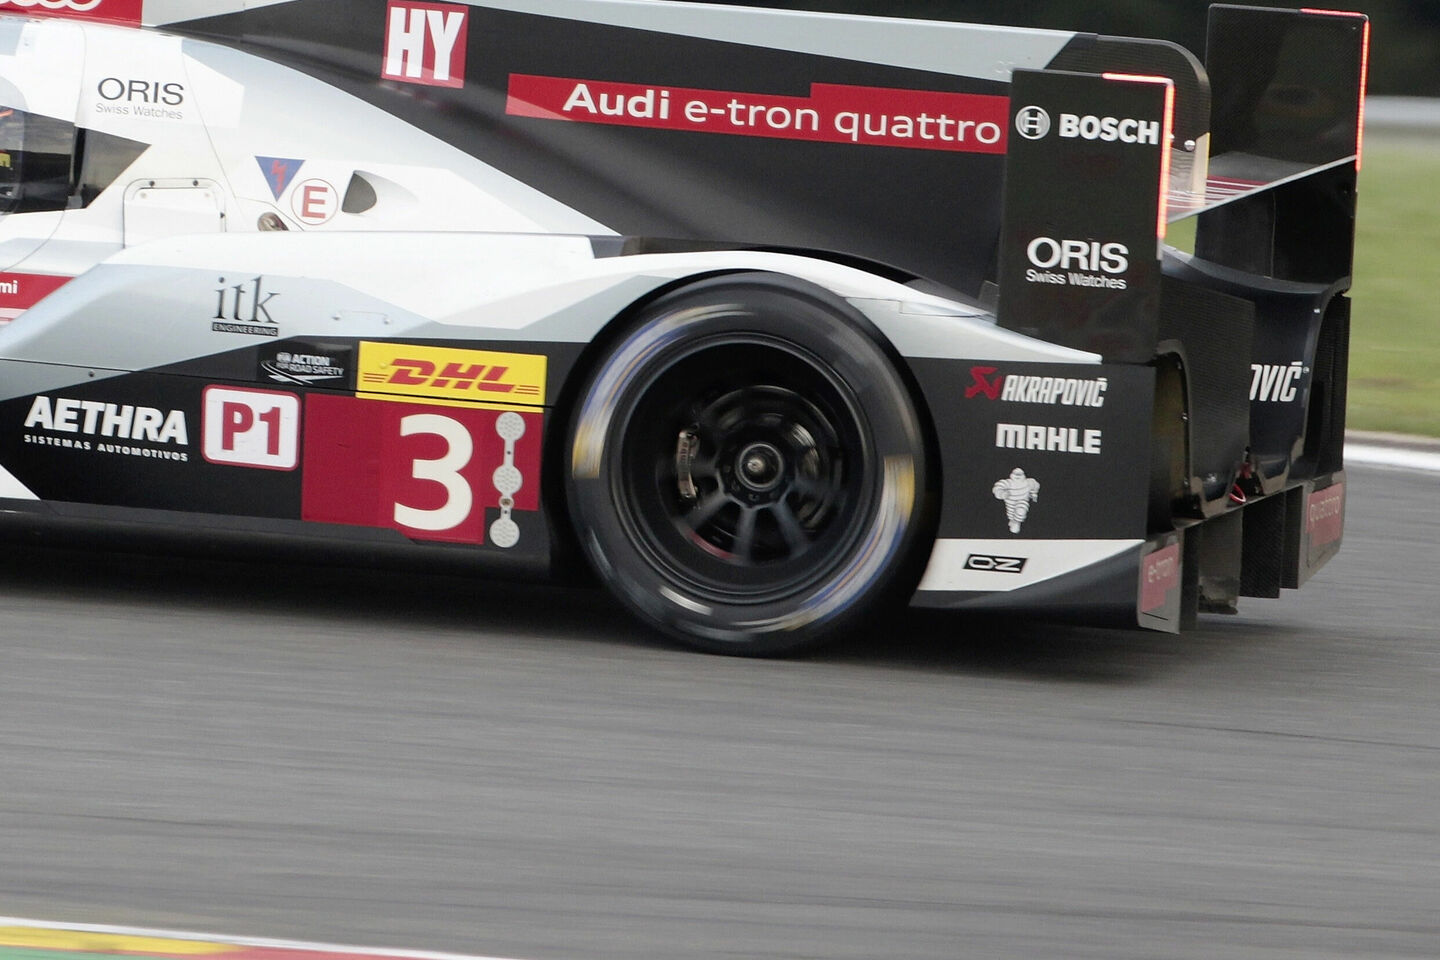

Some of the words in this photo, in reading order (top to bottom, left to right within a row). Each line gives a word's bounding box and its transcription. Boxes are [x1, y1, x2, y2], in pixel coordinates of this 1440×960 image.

[385, 6, 465, 81] HY
[97, 77, 184, 106] ORIS
[95, 102, 129, 115] Swiss
[133, 105, 184, 120] Watches
[562, 83, 670, 120] Audi
[683, 97, 819, 131] e-tron
[833, 110, 1001, 144] quattro
[1058, 113, 1160, 145] BOSCH
[301, 185, 328, 219] E
[1026, 236, 1129, 274] ORIS
[1025, 268, 1067, 285] Swiss
[1067, 271, 1128, 290] Watches
[212, 274, 281, 324] itk
[213, 323, 278, 336] ENGINEERING
[288, 362, 313, 374] ROAD
[312, 365, 345, 376] SAFETY
[291, 353, 330, 366] ACTION
[387, 358, 516, 393] DHL
[23, 395, 189, 446] AETHRA
[221, 401, 282, 456] P1
[23, 434, 92, 451] SISTEMAS
[96, 442, 189, 462] AUTOMOTIVOS
[995, 423, 1102, 455] MAHLE
[393, 413, 474, 531] 3
